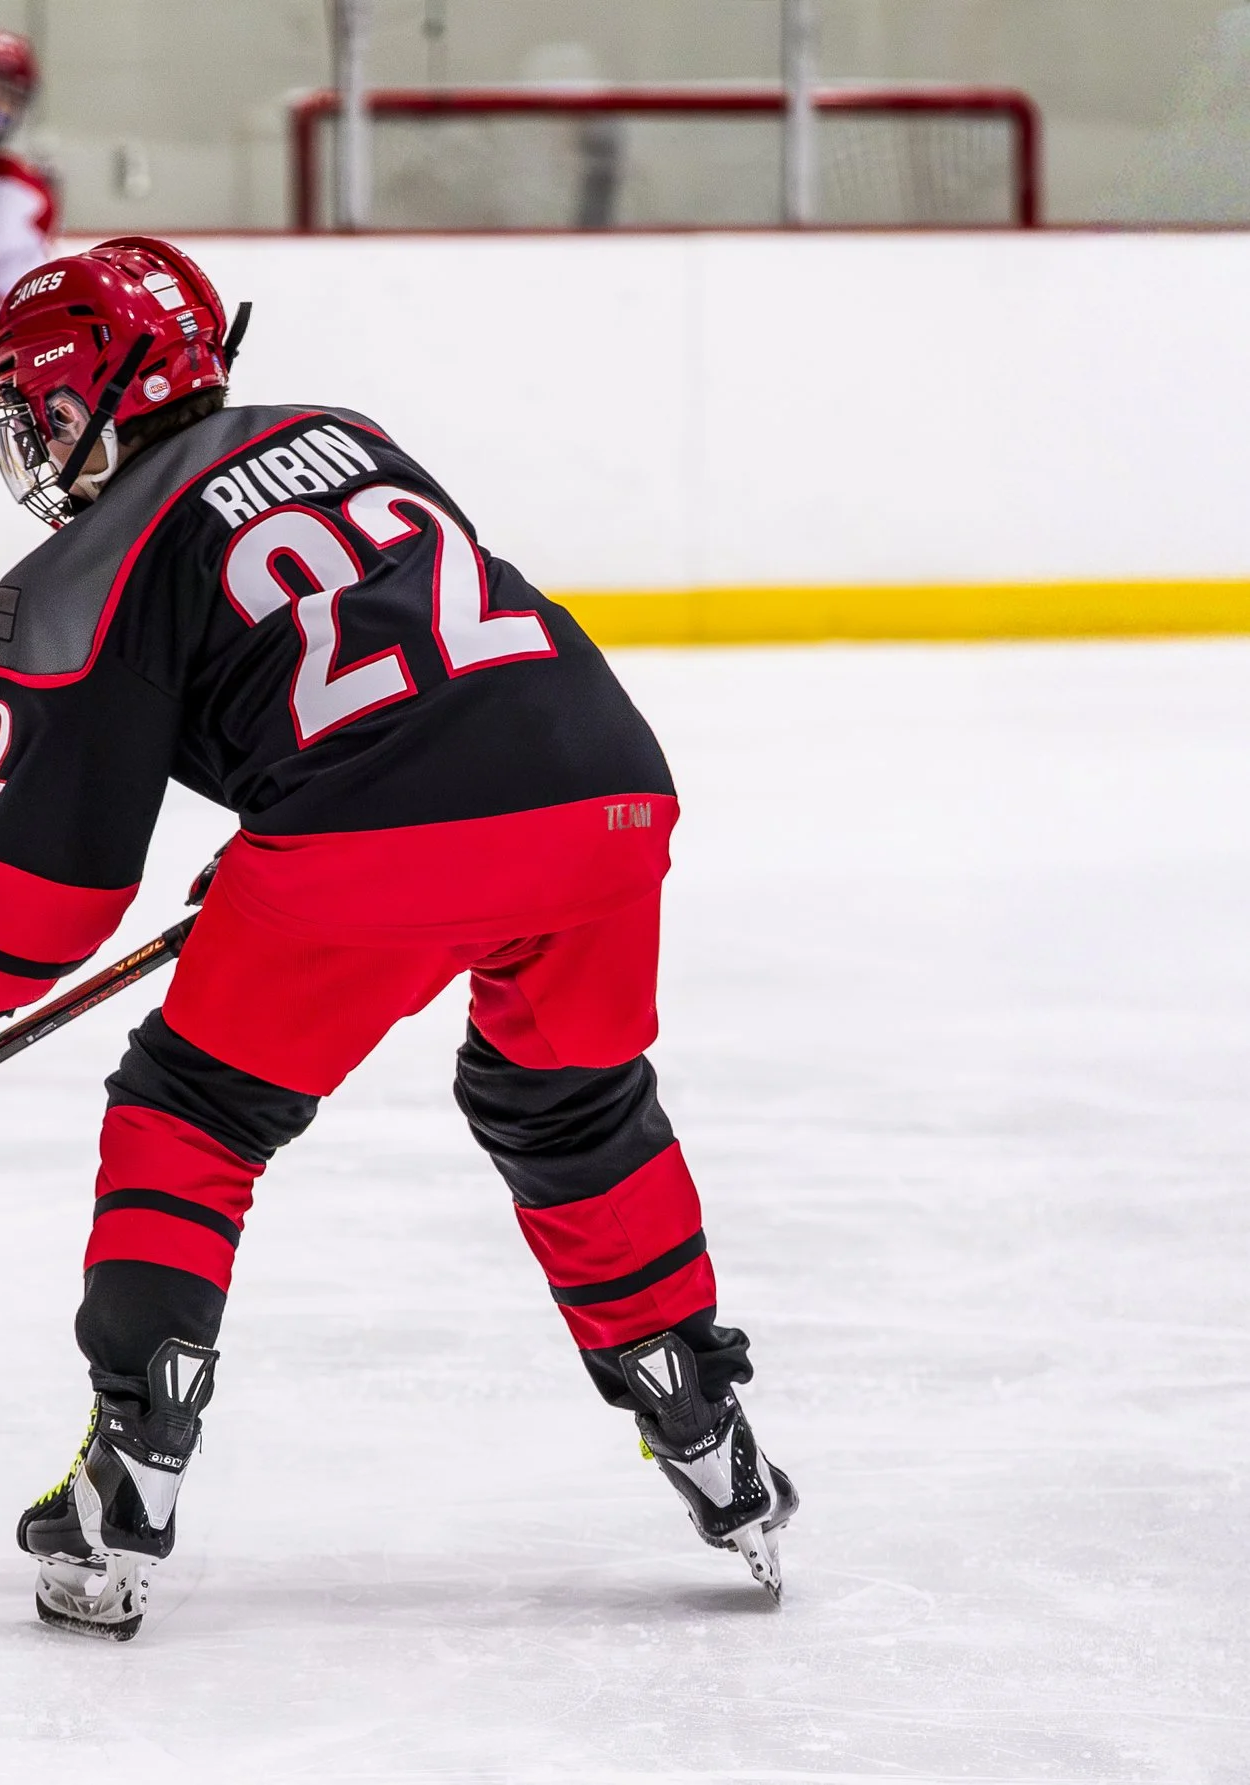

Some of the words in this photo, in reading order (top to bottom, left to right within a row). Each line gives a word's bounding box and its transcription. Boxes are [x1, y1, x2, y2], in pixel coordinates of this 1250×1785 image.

[34, 342, 75, 367] CCM
[201, 424, 379, 529] RUBIN
[221, 483, 559, 752] 22
[603, 802, 651, 831] TEAM
